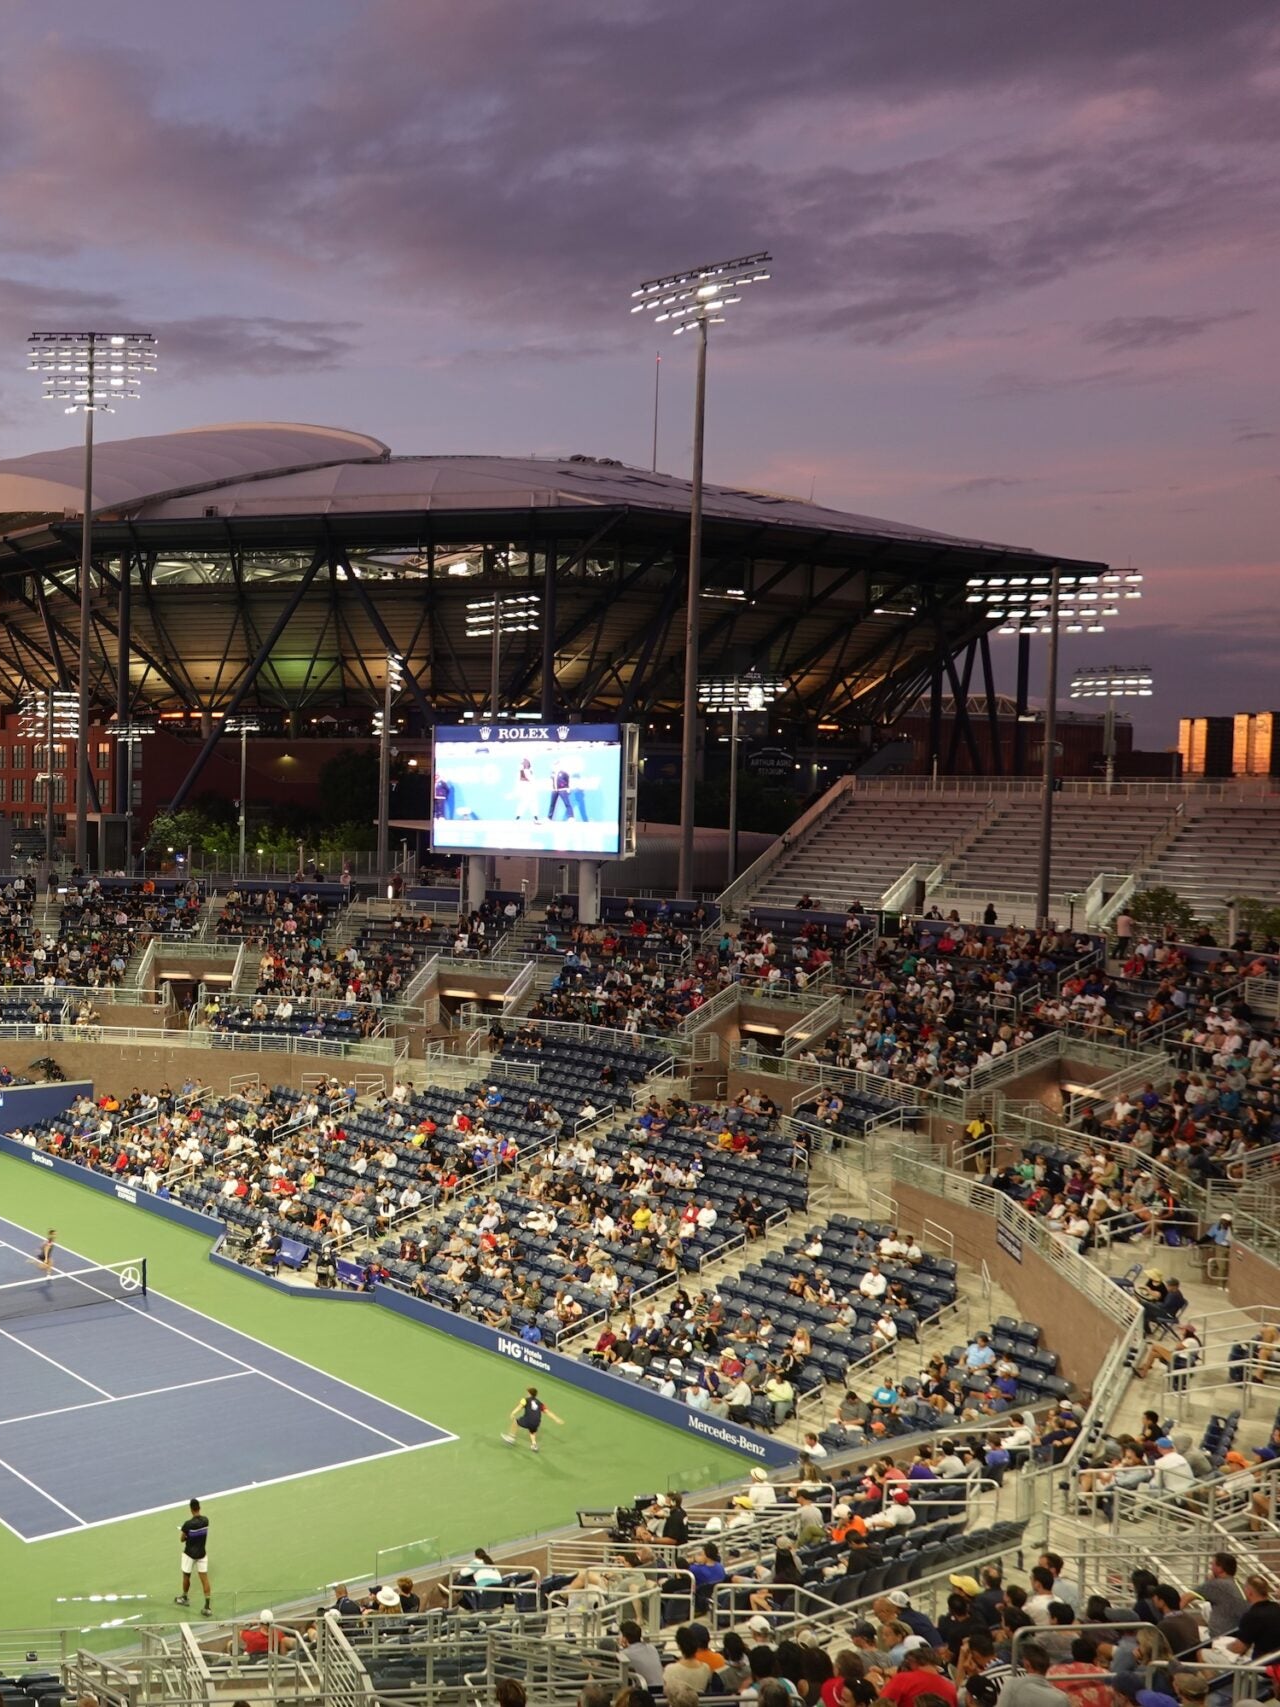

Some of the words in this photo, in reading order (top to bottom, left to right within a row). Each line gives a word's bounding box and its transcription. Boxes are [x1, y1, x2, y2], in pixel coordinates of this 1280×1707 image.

[498, 728, 549, 739] ROLEX
[751, 759, 774, 767] ARTHUR
[391, 783, 397, 791] 7
[498, 1337, 522, 1359] IHG
[524, 1347, 542, 1360] Hotels
[529, 1357, 550, 1370] Resorts
[688, 1414, 766, 1457] Mercedes-Benz
